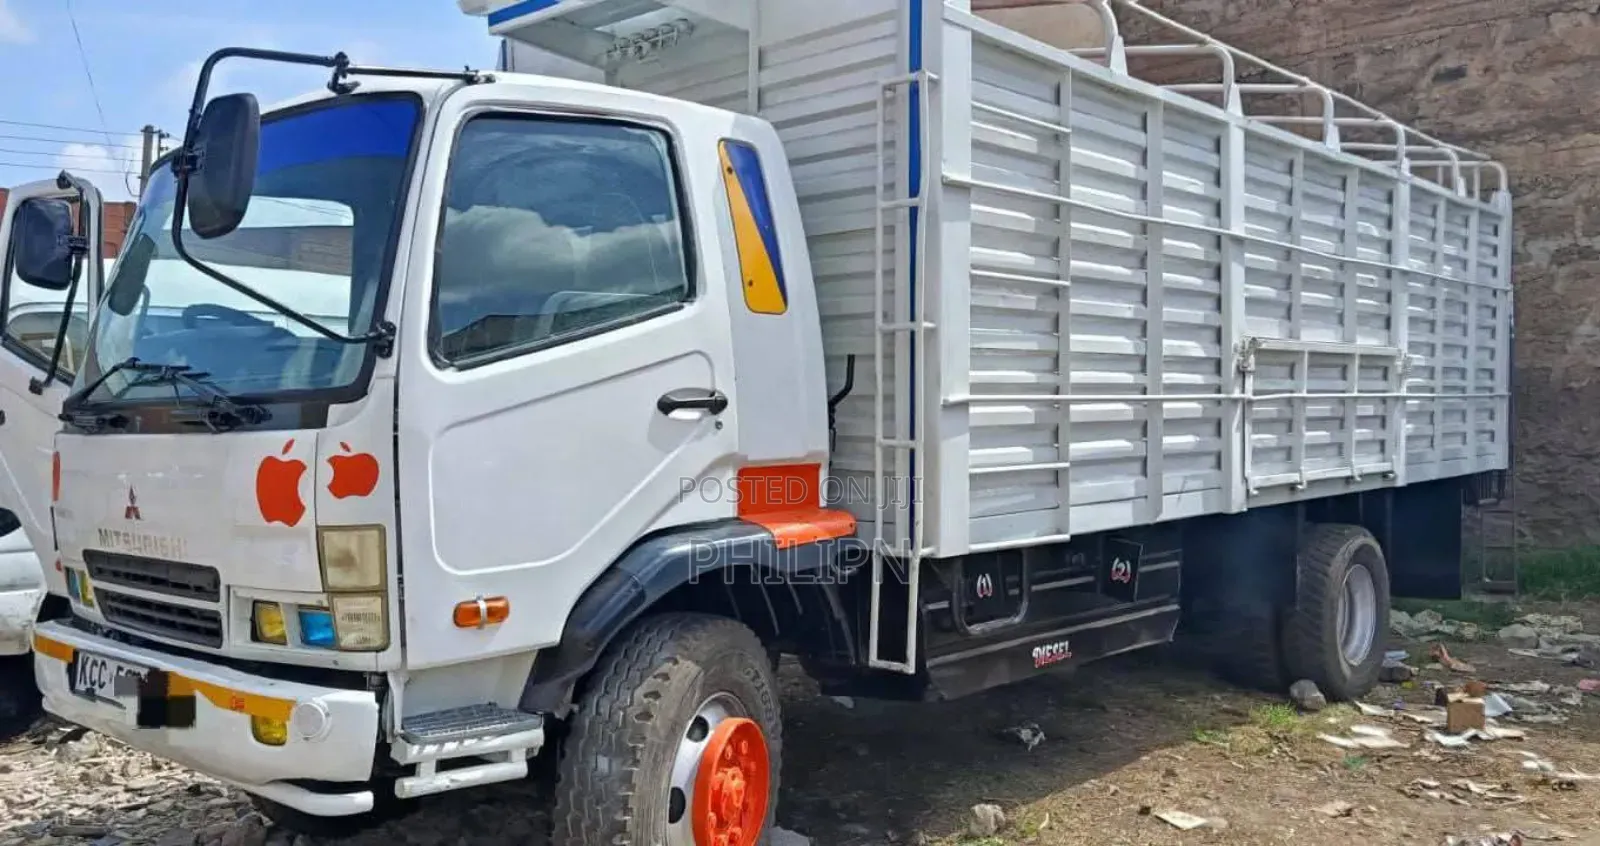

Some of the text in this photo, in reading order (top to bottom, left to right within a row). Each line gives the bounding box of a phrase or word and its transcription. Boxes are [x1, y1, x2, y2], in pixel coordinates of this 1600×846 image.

[1111, 557, 1132, 584] (2)
[976, 573, 993, 598] (1)
[1032, 640, 1073, 668] DIESEL
[79, 655, 108, 689] KCC
